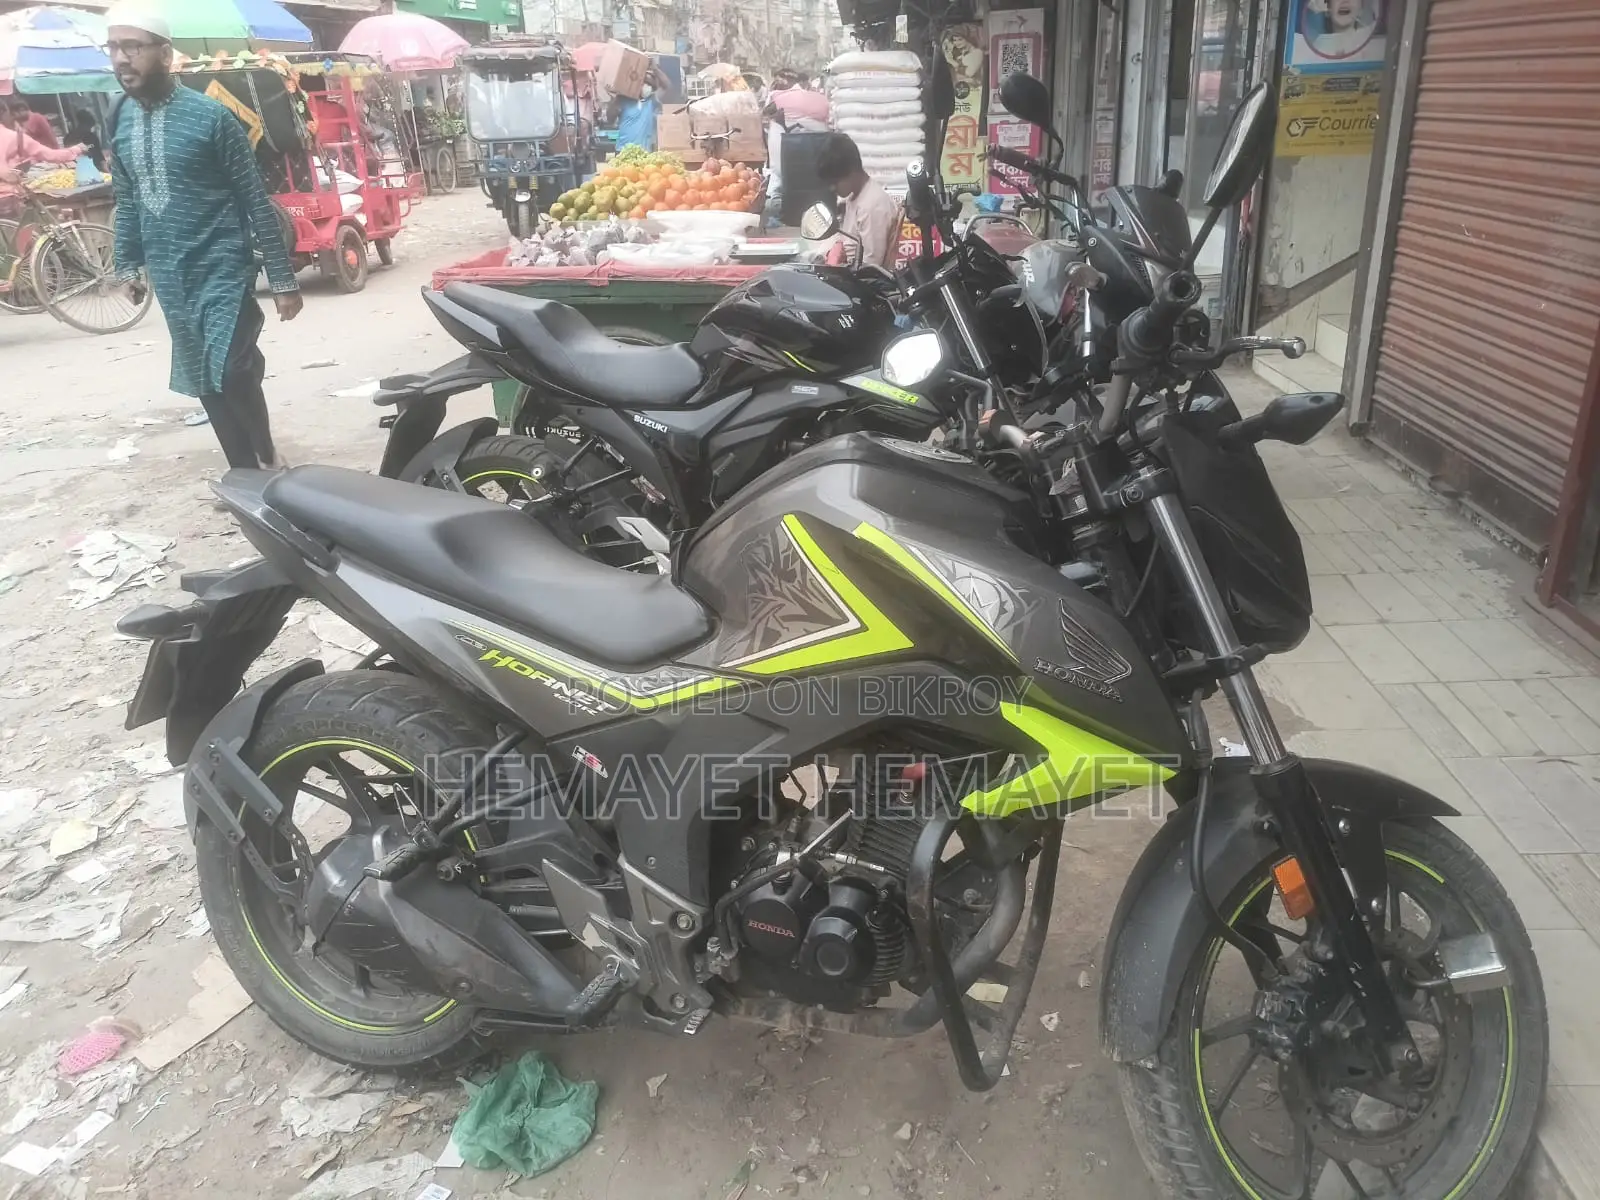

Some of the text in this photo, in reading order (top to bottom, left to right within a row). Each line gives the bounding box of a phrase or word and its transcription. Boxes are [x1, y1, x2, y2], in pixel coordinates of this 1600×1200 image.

[633, 414, 669, 433] SUZUKI
[478, 649, 617, 712] HORNET
[1032, 656, 1123, 704] HONDA
[747, 919, 796, 938] HONDA
